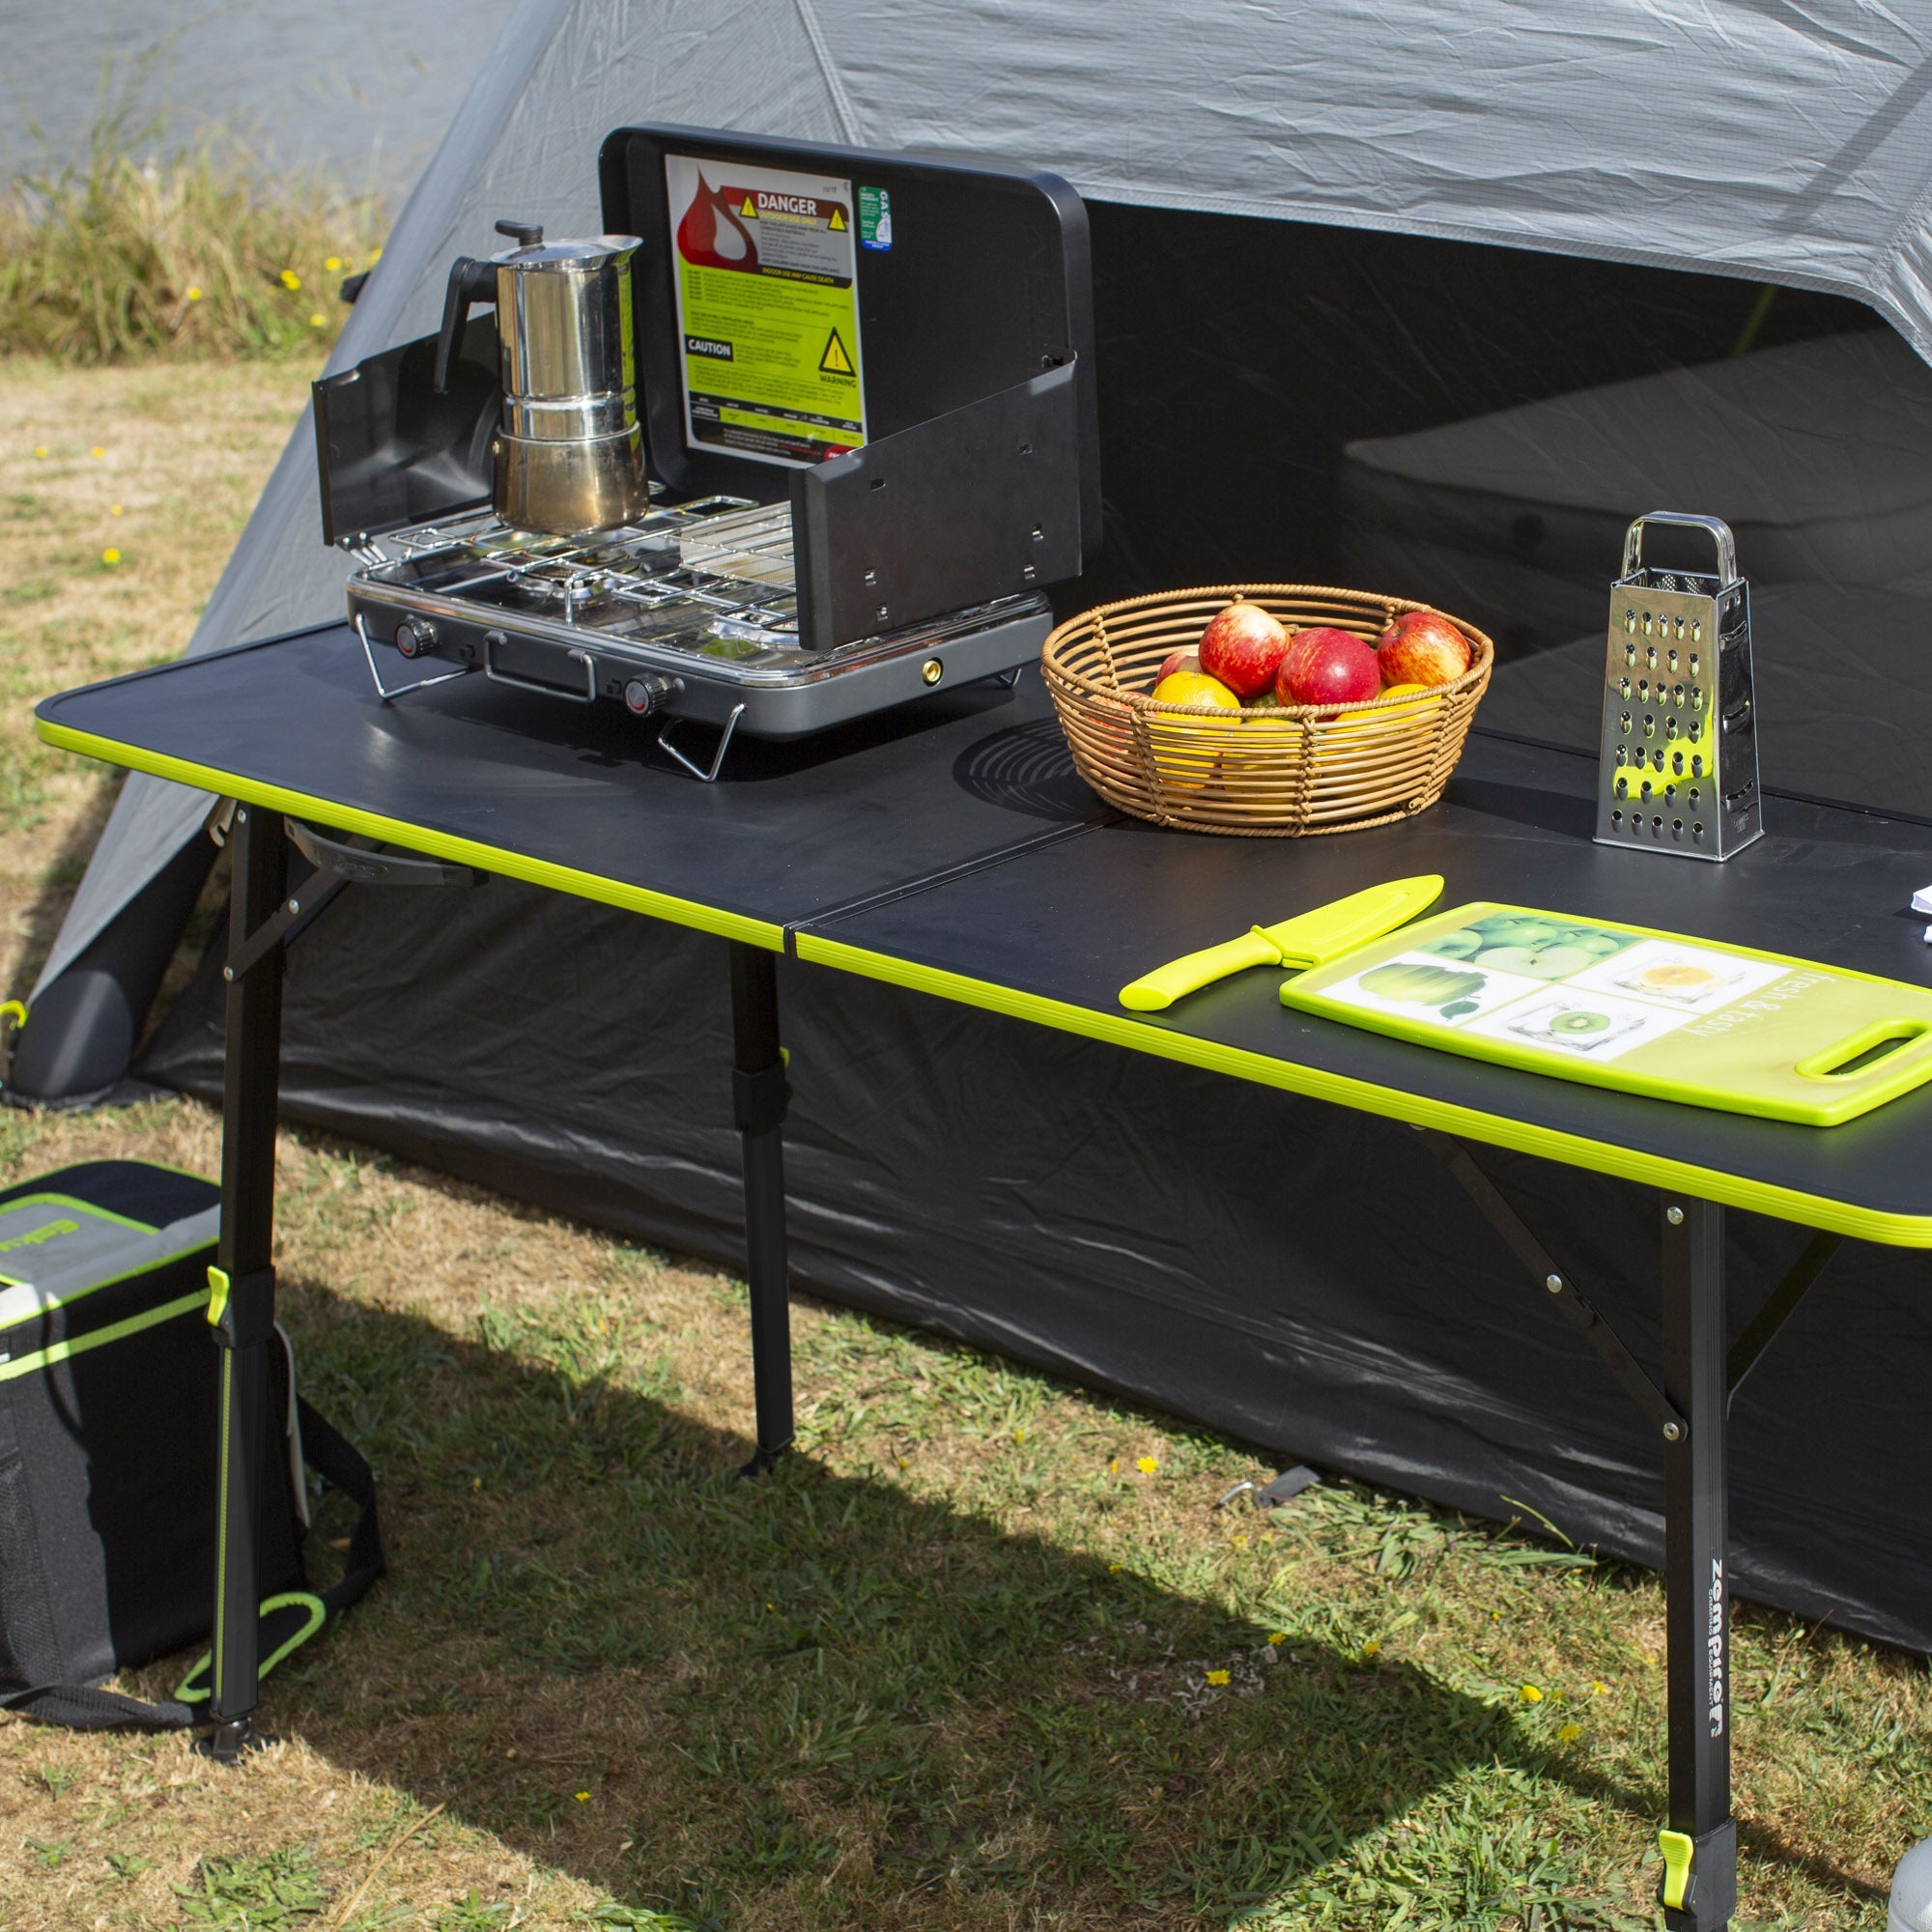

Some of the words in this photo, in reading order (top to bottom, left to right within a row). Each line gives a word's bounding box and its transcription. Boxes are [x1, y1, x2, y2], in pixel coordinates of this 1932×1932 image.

[757, 192, 817, 215] DANGER
[880, 190, 890, 218] GAS
[688, 339, 731, 356] CAUTION
[820, 375, 857, 388] WARNING
[1760, 973, 1837, 1000] fresh
[1738, 999, 1781, 1010] &
[1681, 1009, 1760, 1037] tasty
[1708, 1558, 1722, 1703] zempire
